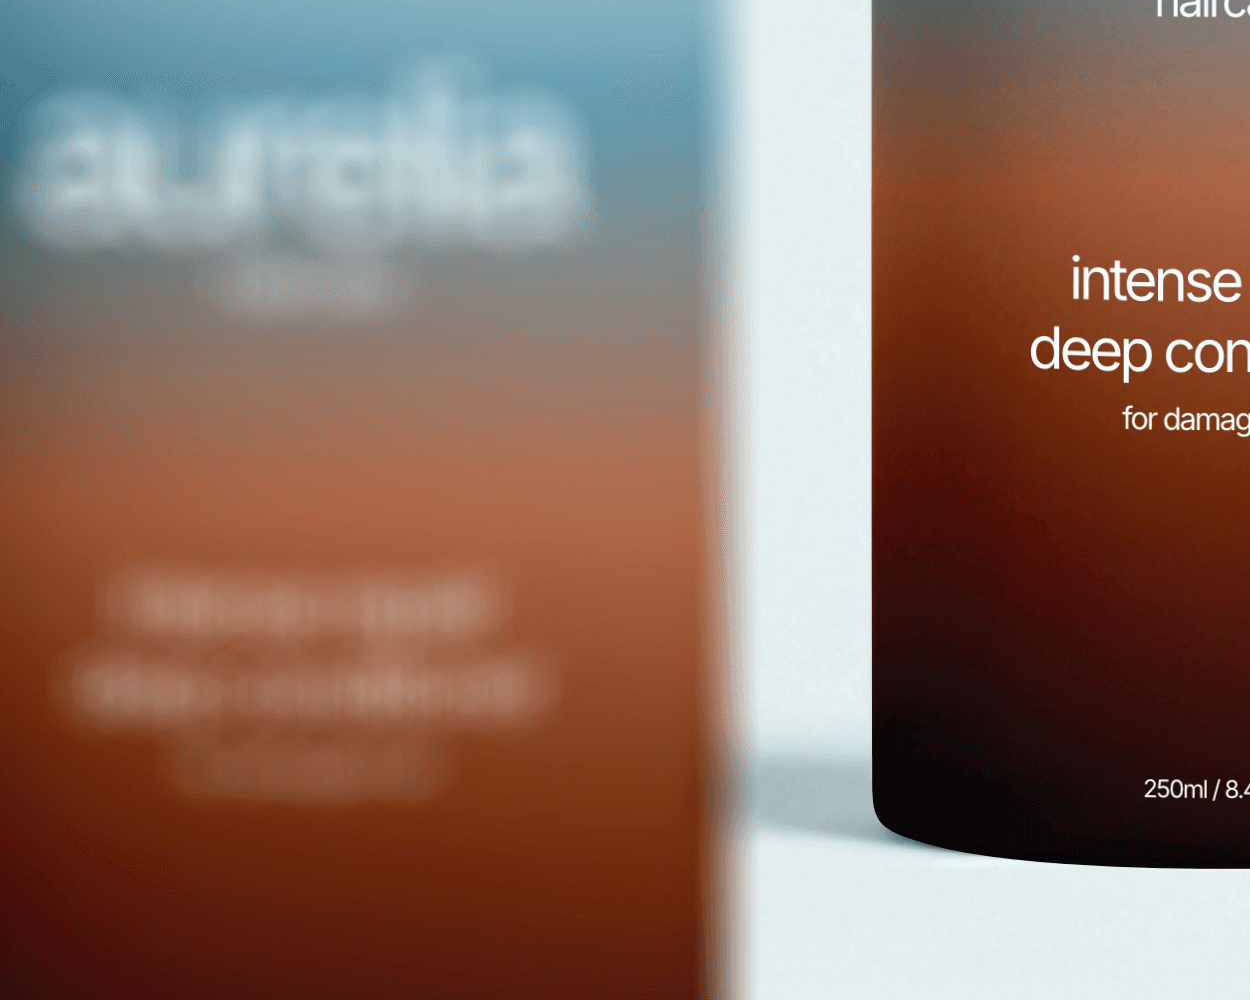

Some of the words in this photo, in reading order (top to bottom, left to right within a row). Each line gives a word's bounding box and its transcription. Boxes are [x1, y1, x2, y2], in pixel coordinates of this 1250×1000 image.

[1071, 254, 1243, 303] intense
[1030, 325, 1153, 384] deep
[1121, 404, 1159, 432] for
[1144, 778, 1208, 799] 250ml
[1212, 778, 1221, 802] /
